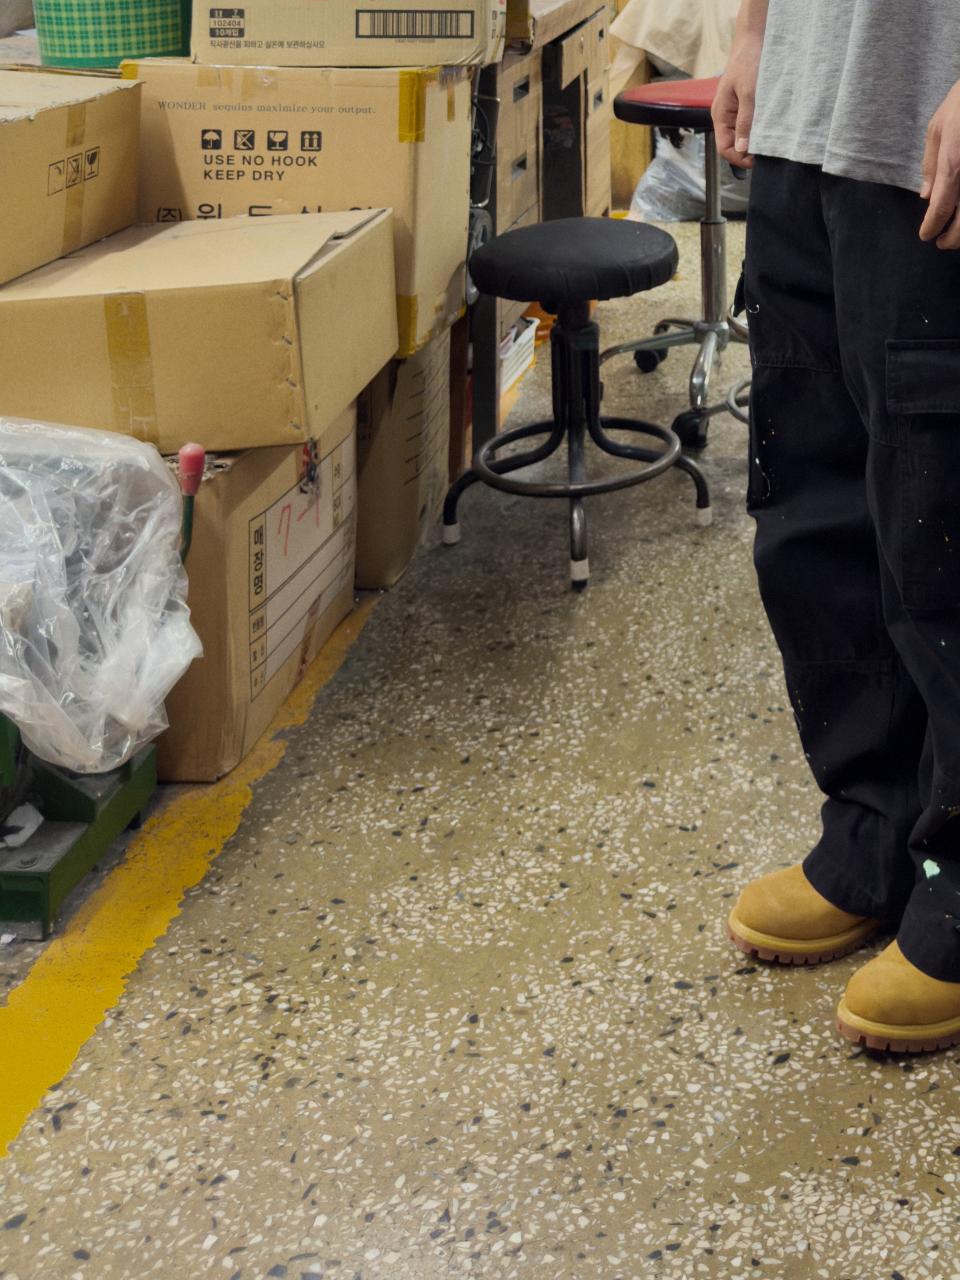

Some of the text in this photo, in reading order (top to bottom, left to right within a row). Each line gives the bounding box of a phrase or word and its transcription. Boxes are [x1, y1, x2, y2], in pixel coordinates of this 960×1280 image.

[158, 100, 376, 115] WONDER sequins maximize your output.
[203, 154, 318, 167] USE NO HOOK
[203, 169, 285, 181] KEEP DRY
